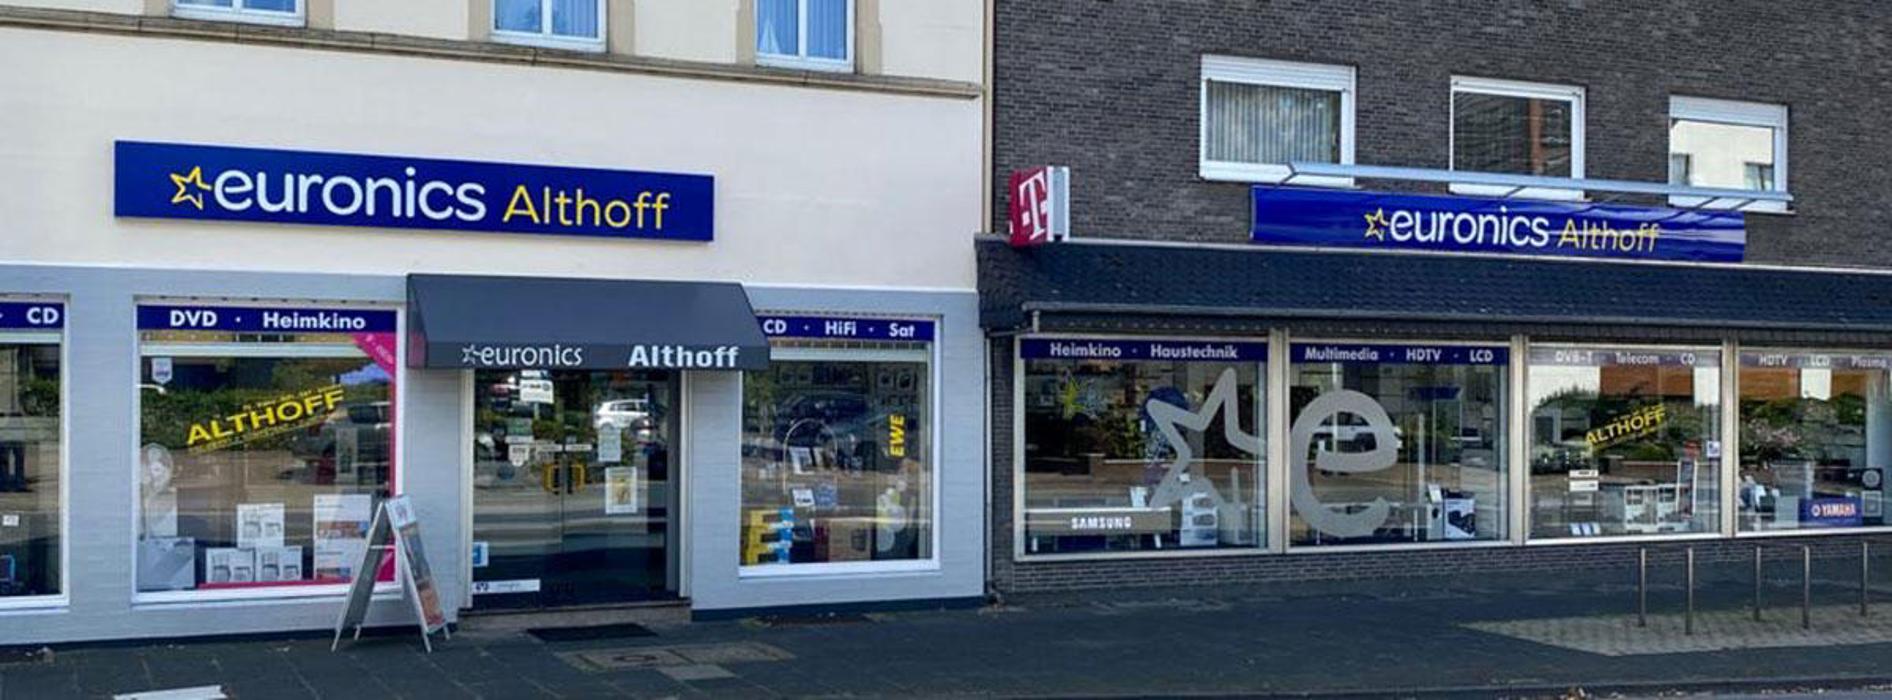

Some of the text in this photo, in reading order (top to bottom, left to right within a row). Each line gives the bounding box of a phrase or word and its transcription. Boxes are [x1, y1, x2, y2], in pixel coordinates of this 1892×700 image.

[213, 166, 671, 229] euronics Althoff
[1389, 206, 1660, 253] euronics Althoff
[26, 306, 60, 325] CD
[169, 309, 366, 330] DVD Heimkino
[763, 319, 915, 338] CD HiFi Sat
[481, 344, 740, 368] euronics Althoff
[1049, 341, 1239, 360] Heimkino Haustechnik
[1305, 346, 1494, 363] Multimedia HDTV LCD
[1555, 350, 1696, 365] DVB-T Telecom CD
[1759, 353, 1788, 367] HDTV
[187, 389, 344, 445] ALTHOFF
[890, 414, 905, 457] EWE
[1585, 408, 1666, 446] ALTHOFF
[1821, 503, 1856, 517] YAMAHA
[1070, 516, 1132, 531] SAMSUNG
